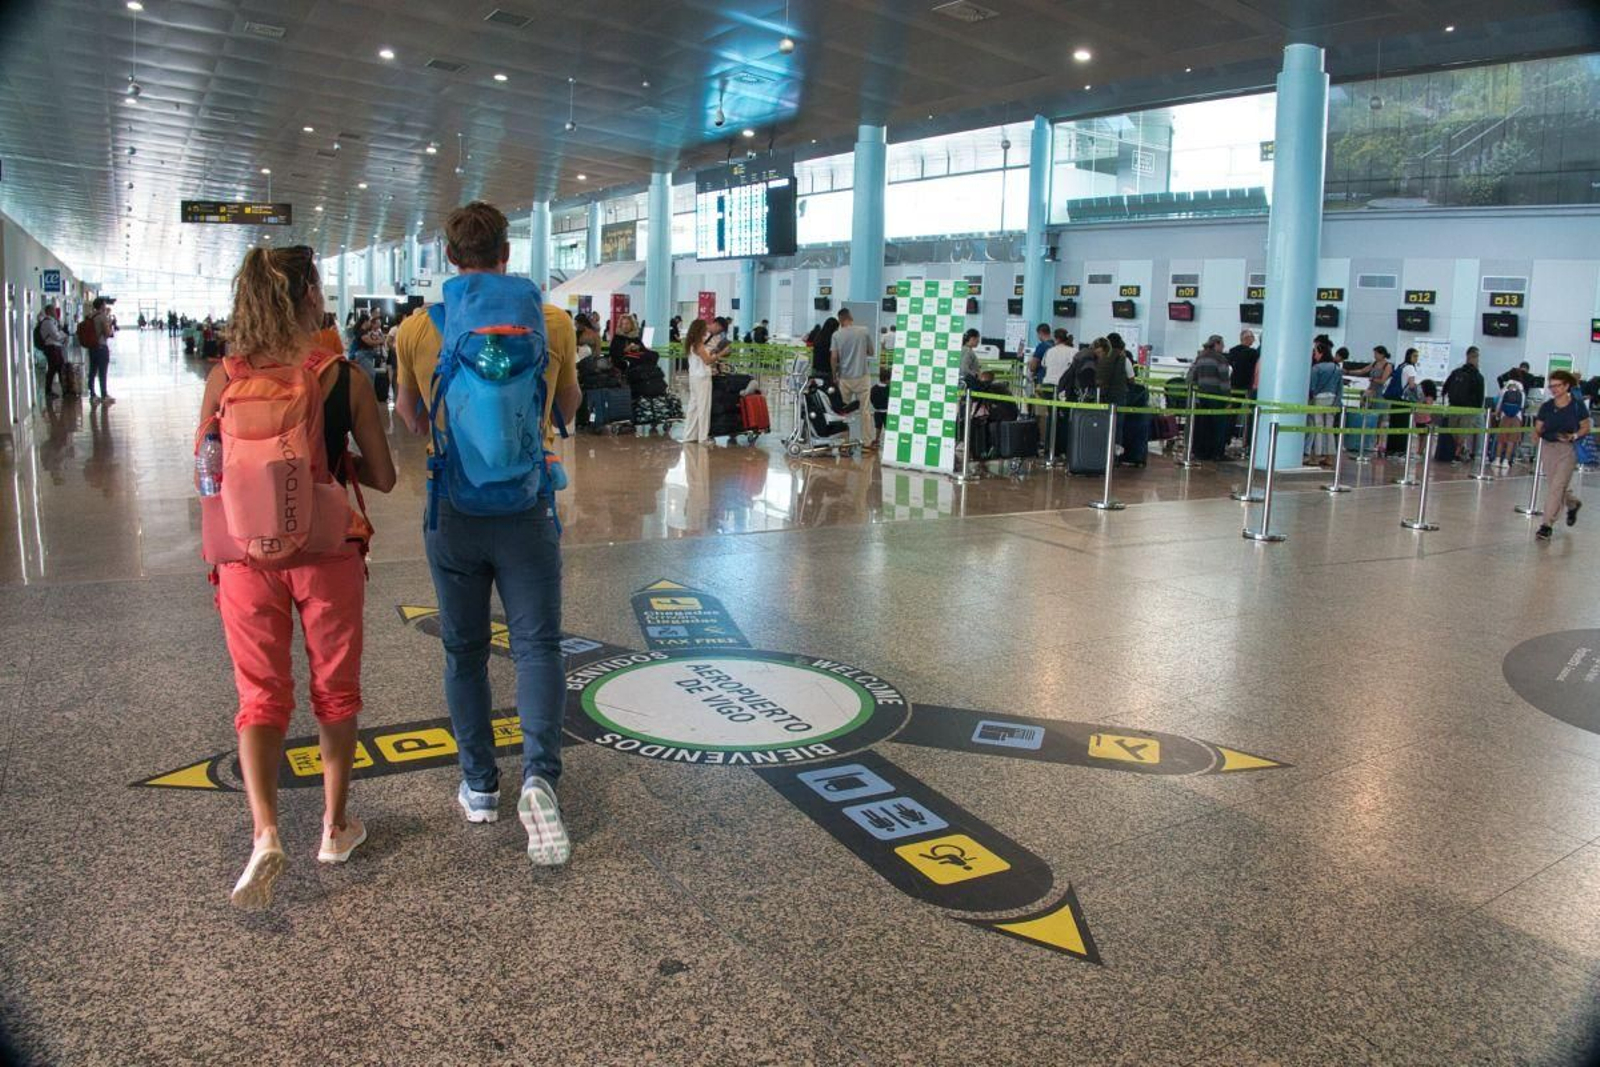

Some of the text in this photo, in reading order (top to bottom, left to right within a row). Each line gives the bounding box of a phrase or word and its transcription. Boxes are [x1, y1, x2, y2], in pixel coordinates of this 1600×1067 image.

[1327, 290, 1339, 299] 11
[1417, 292, 1431, 303] 12
[1503, 295, 1518, 306] 13
[279, 431, 298, 533] ORTOVOX
[685, 663, 812, 732] AEROPUERTO
[813, 659, 904, 706] WELCOME
[674, 678, 756, 723] DE VIGO
[392, 738, 447, 753] P
[594, 733, 838, 766] BIENVENIDOS
